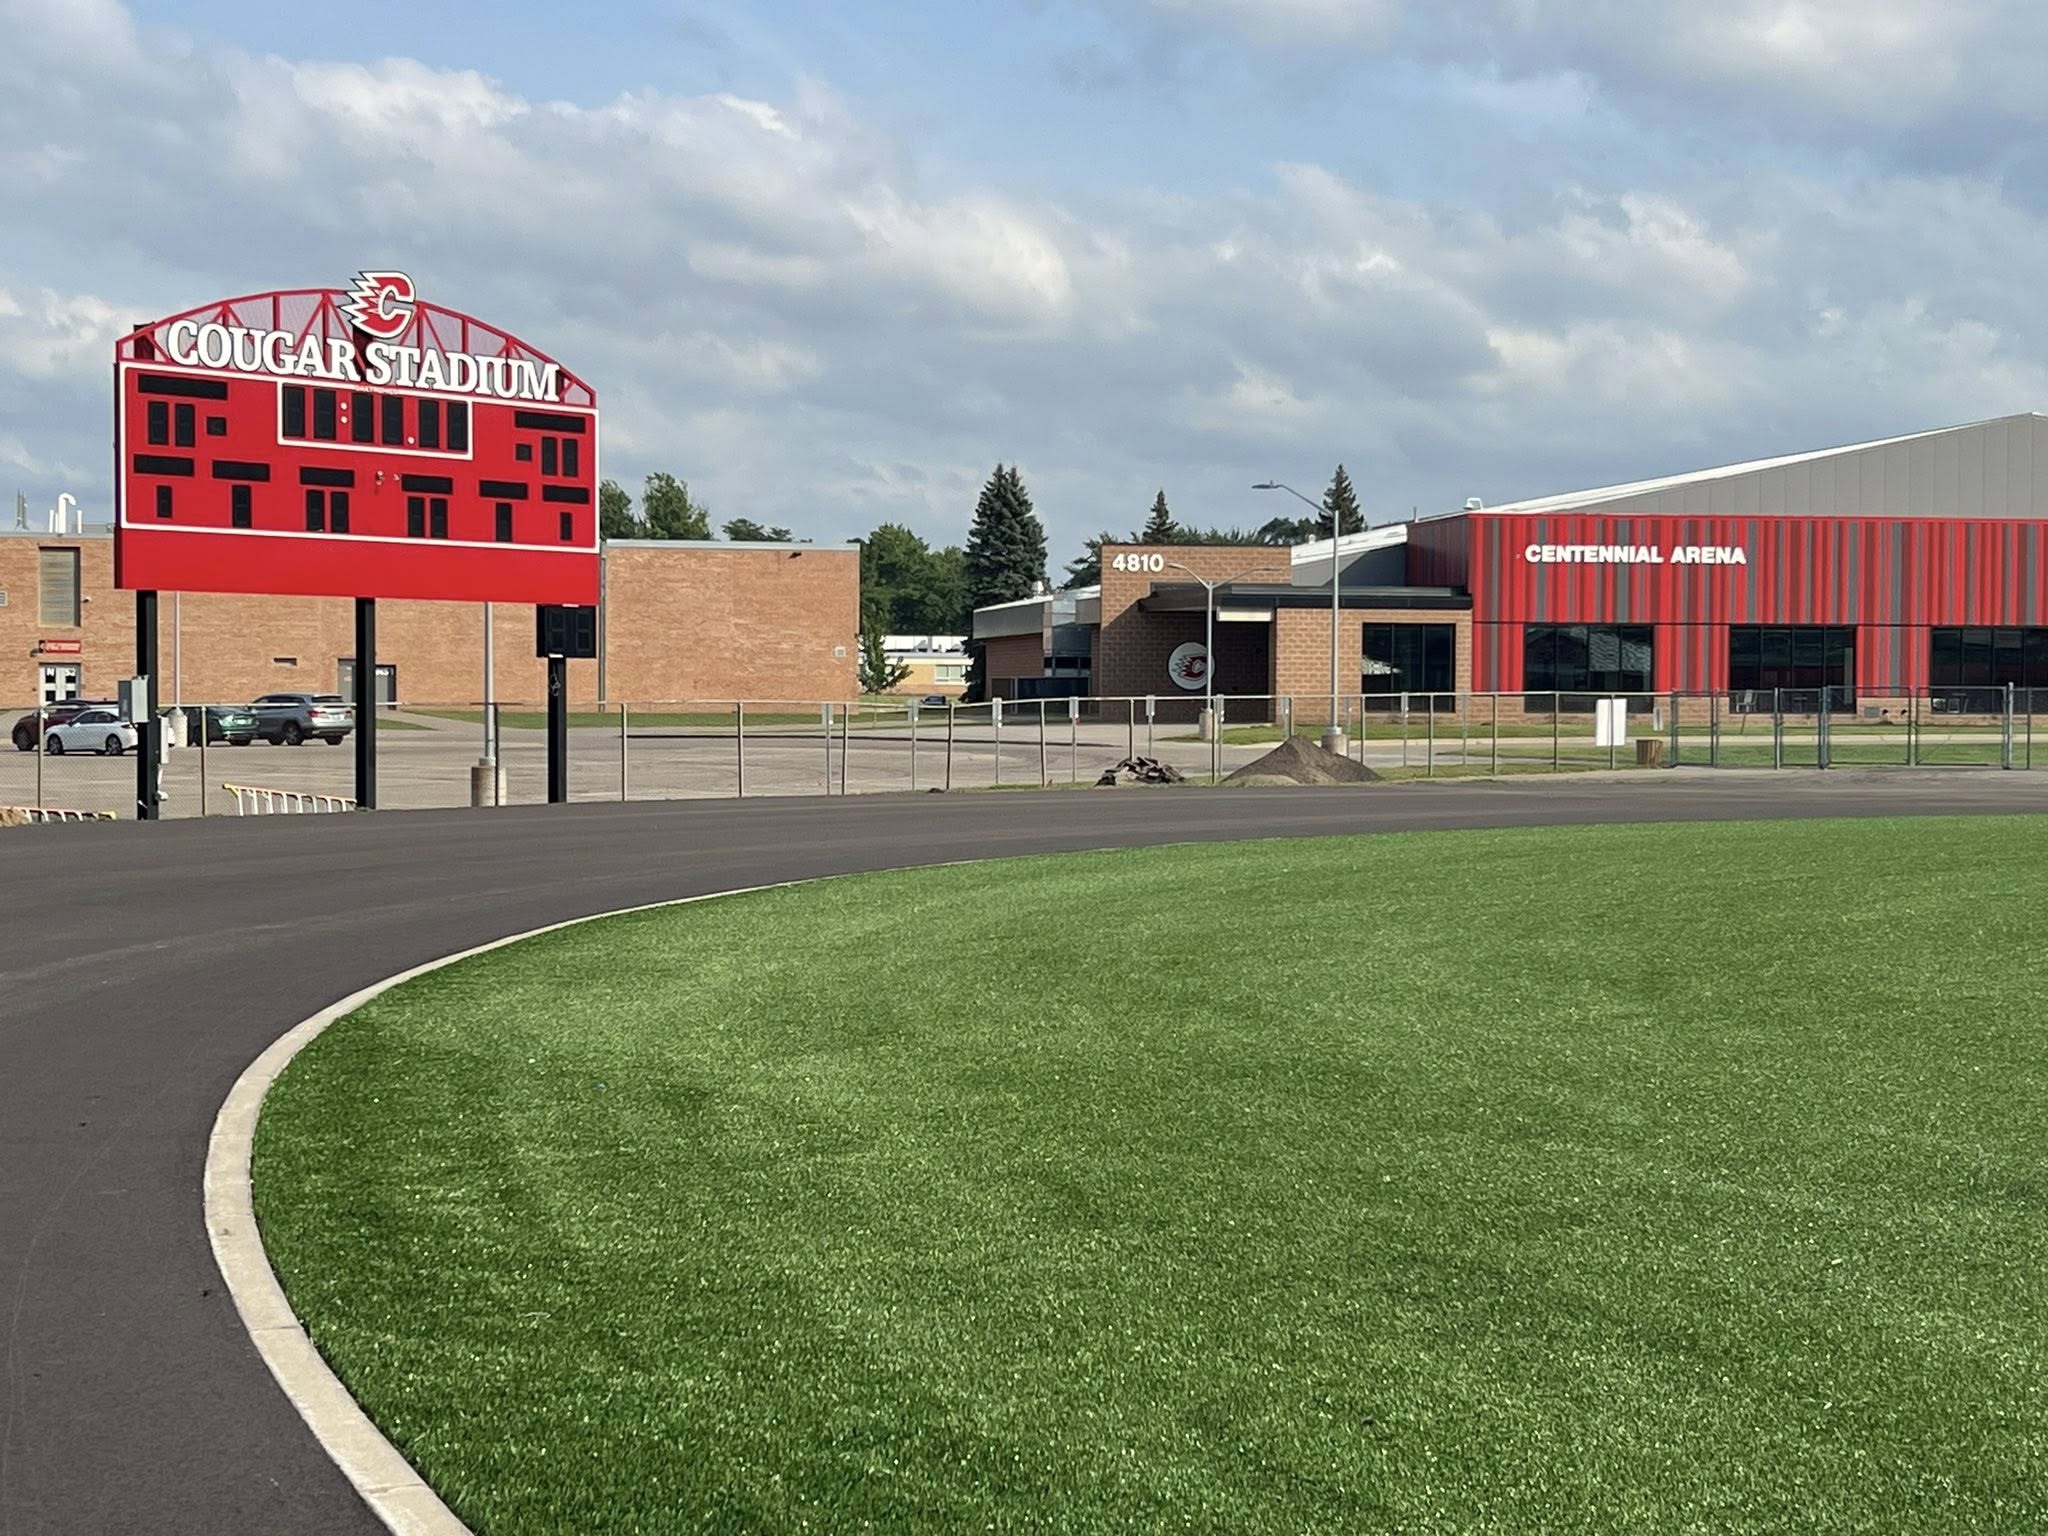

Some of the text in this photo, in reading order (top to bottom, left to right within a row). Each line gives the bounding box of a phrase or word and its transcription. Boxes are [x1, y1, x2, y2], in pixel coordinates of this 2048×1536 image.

[167, 319, 560, 402] COUGAR STADIUM
[1112, 553, 1164, 572] 4810
[1525, 544, 1747, 564] CENTENNIAL ARENA
